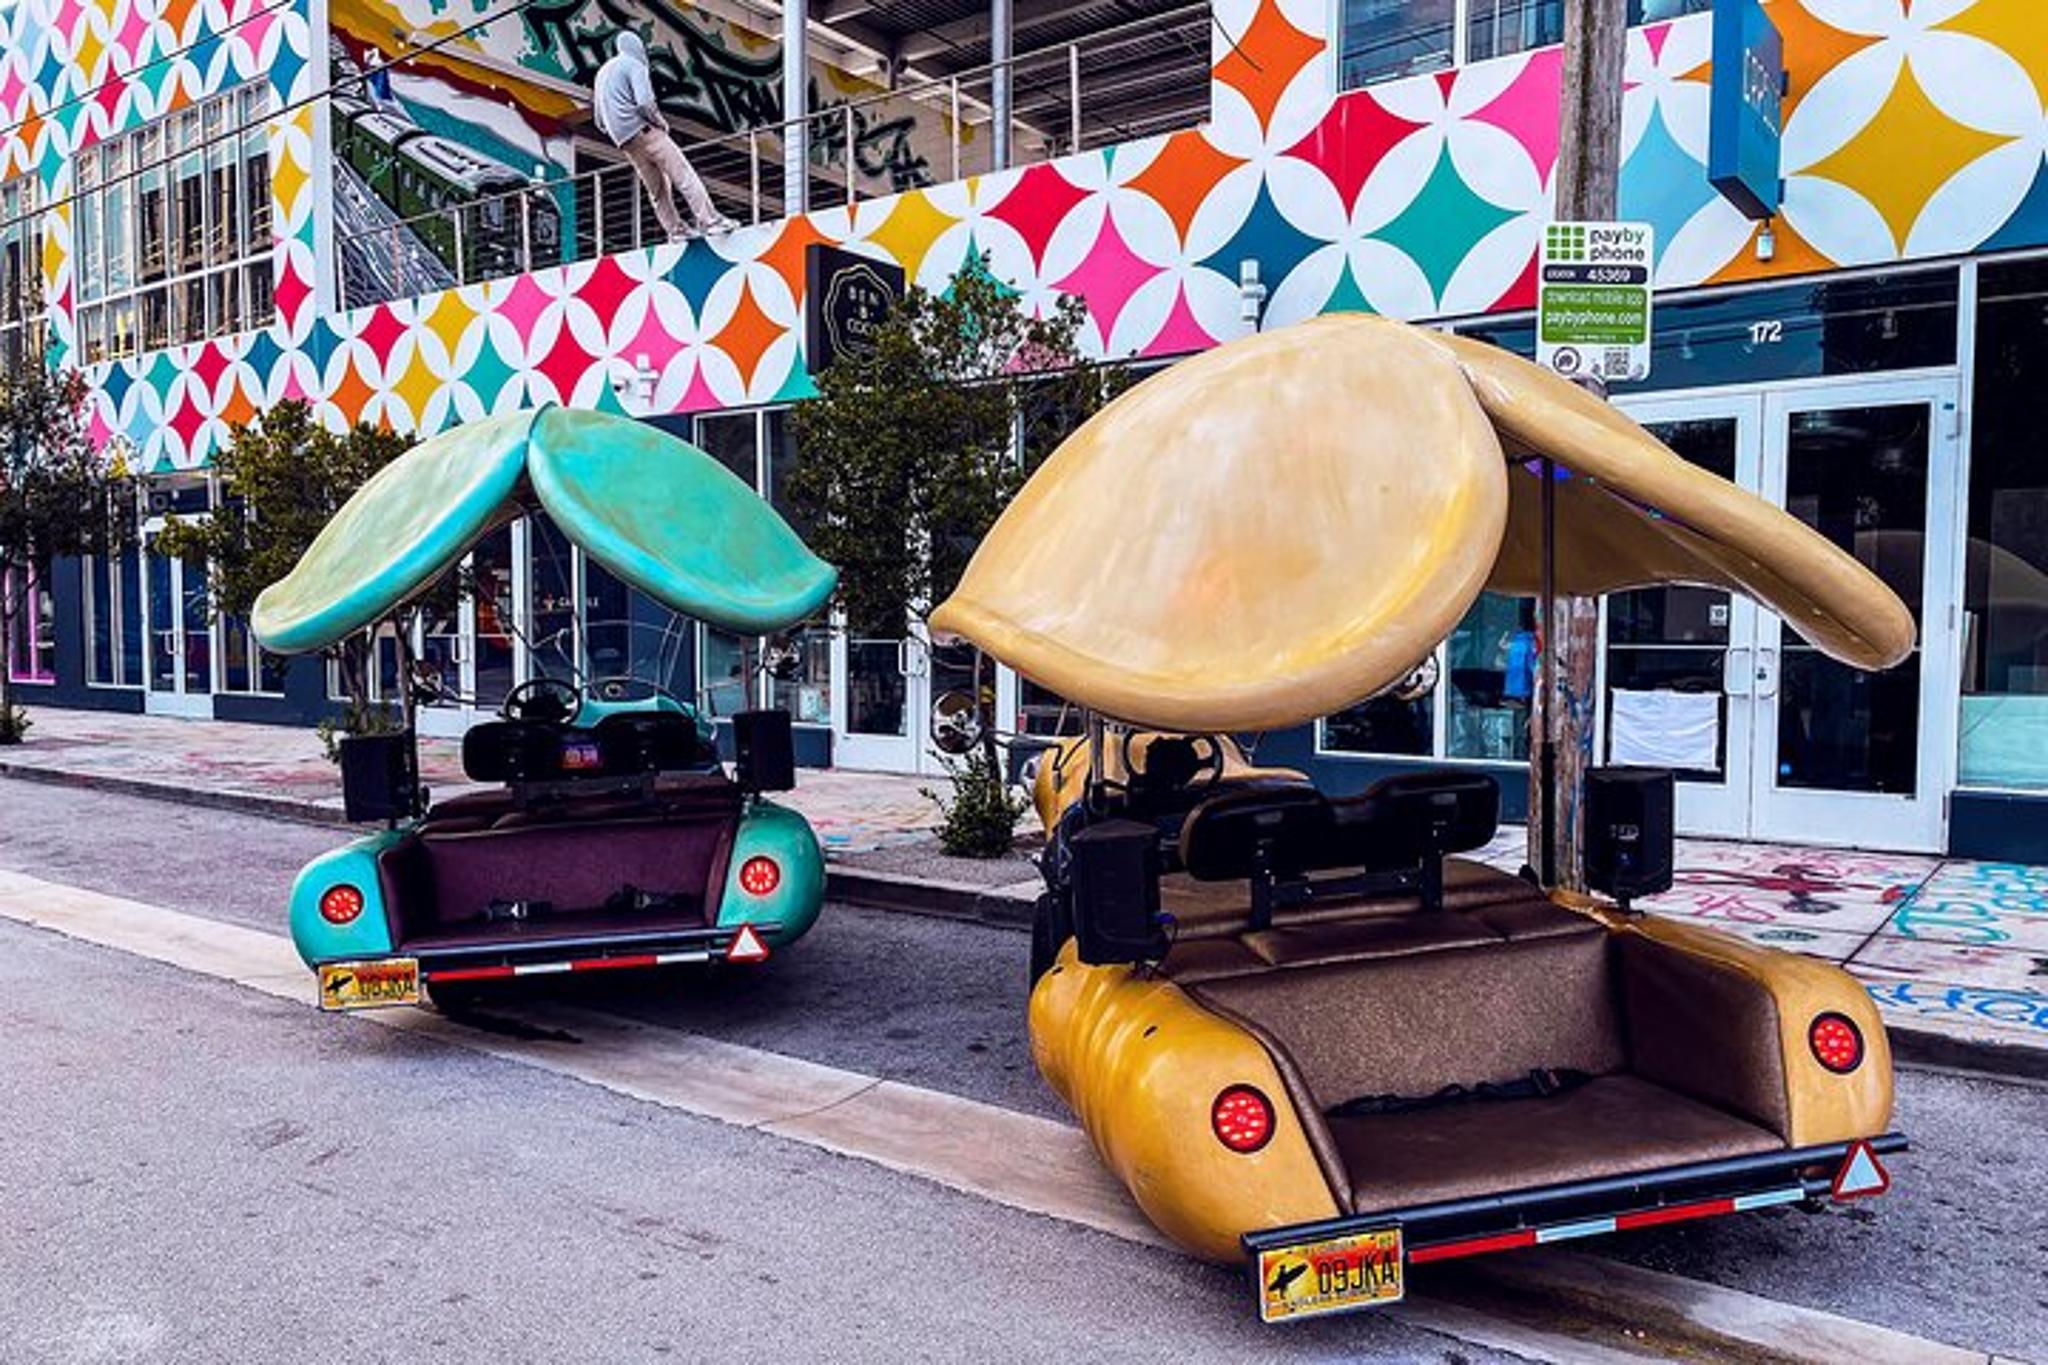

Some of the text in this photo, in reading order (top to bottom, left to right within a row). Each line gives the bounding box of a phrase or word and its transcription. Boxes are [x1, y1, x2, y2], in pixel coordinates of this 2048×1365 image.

[1590, 227, 1644, 245] payby
[1590, 245, 1645, 262] phone
[1546, 309, 1643, 328] paybyphone.com
[1748, 320, 1782, 344] 172
[1318, 1250, 1395, 1295] 09JKA
